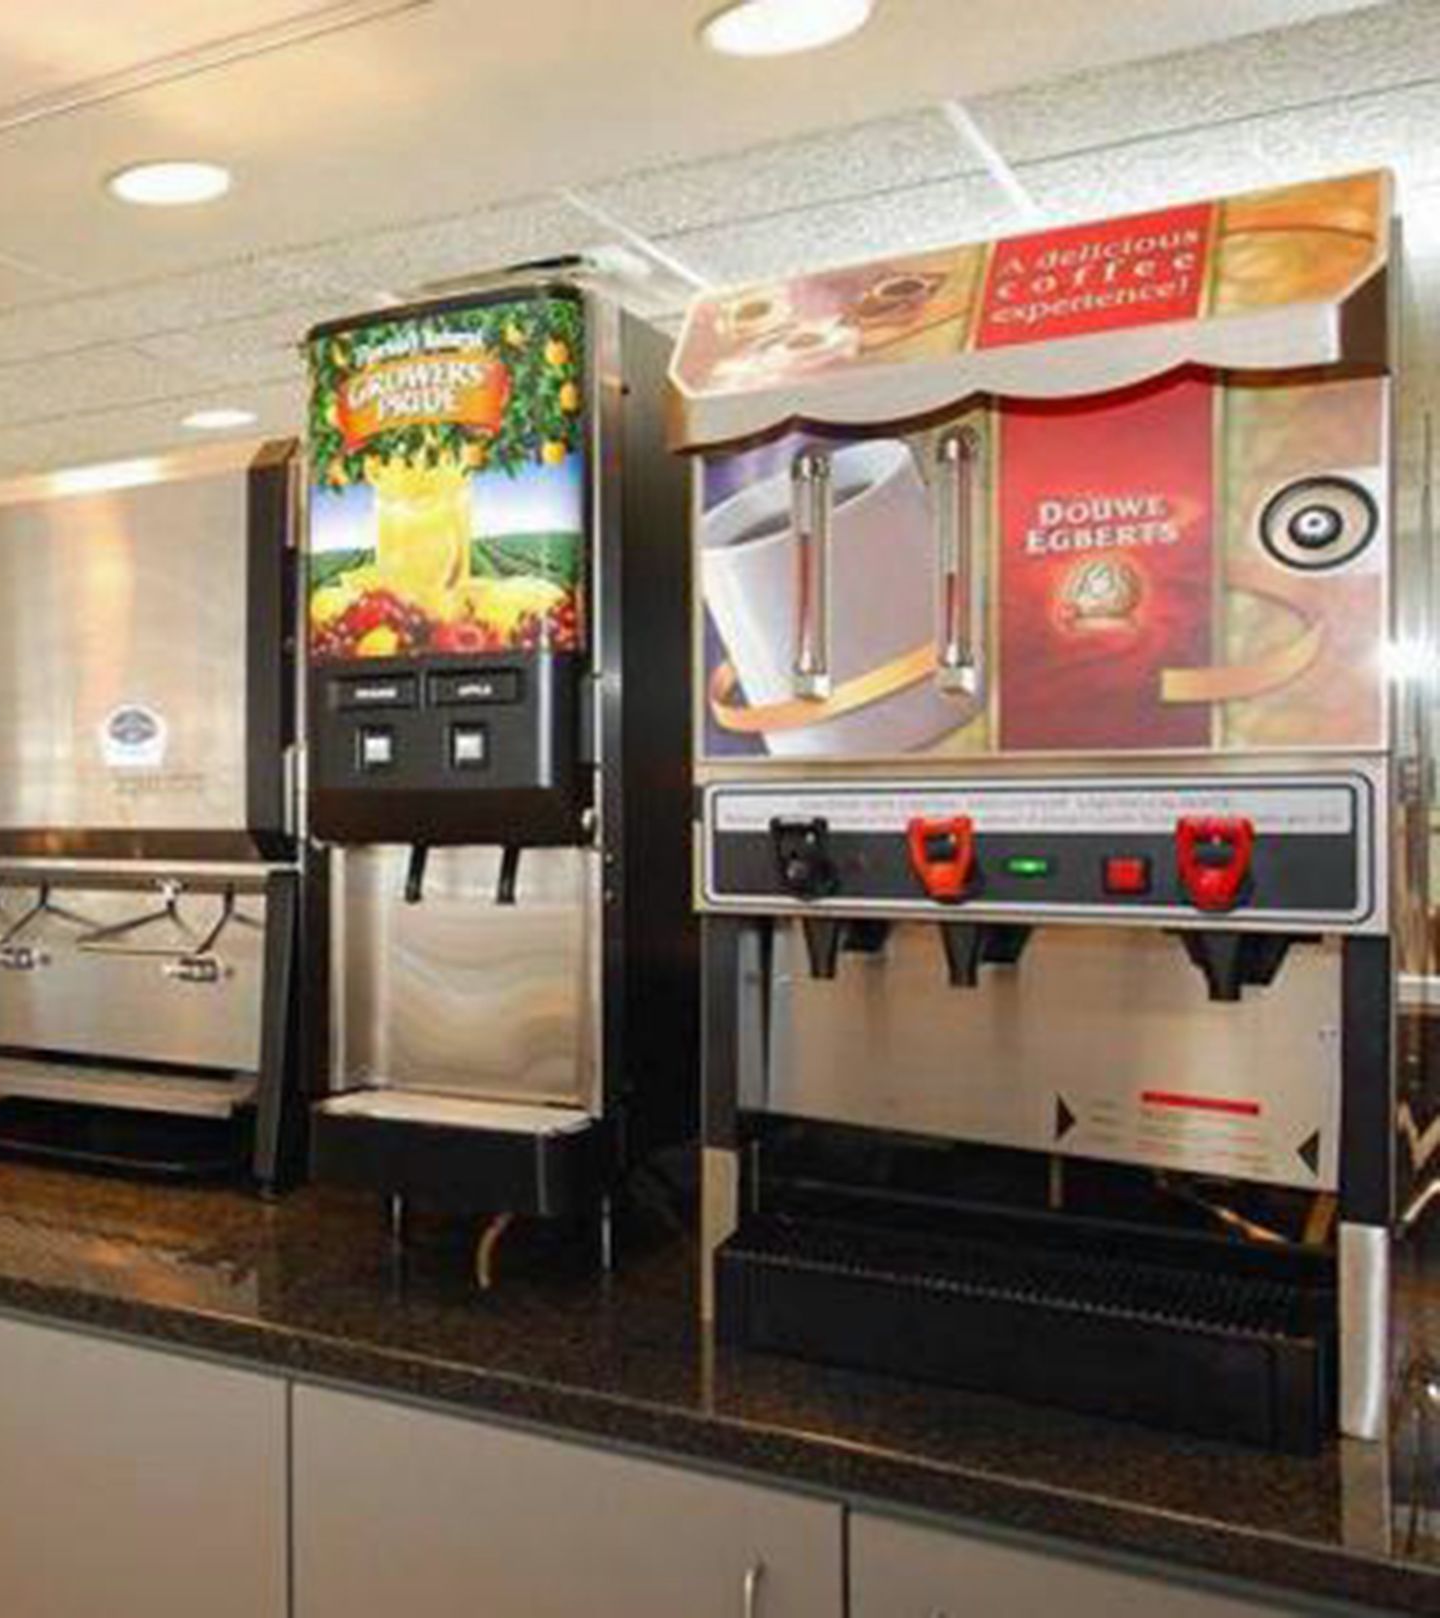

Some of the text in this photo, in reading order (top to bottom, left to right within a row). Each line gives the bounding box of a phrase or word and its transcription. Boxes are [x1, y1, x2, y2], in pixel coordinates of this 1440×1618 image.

[1001, 230, 1198, 275] A delicious
[996, 252, 1196, 299] coffee
[990, 274, 1189, 324] experience!
[1039, 496, 1168, 526] DOUWE
[1026, 521, 1180, 555] EGBERTS
